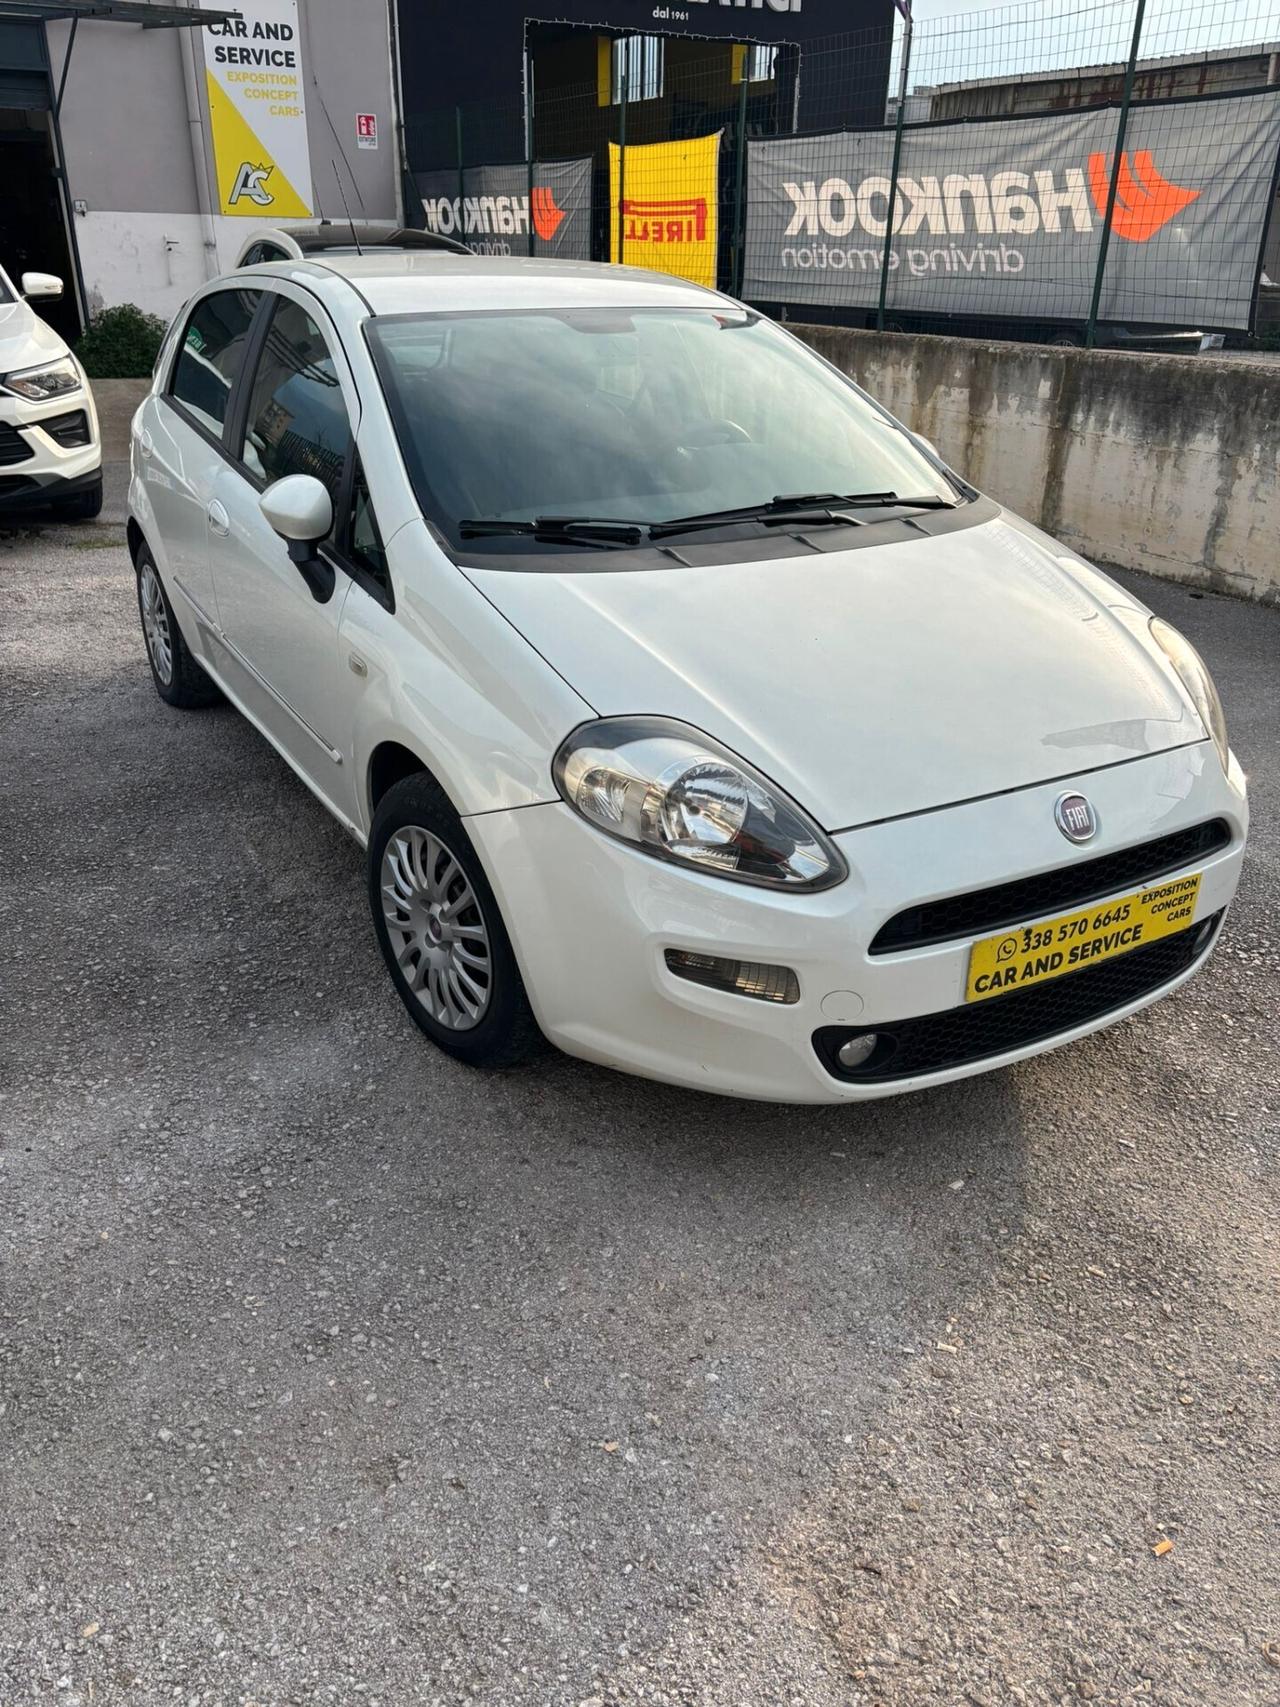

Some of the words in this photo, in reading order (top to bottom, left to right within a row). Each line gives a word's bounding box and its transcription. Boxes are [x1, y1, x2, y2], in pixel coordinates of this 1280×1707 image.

[652, 6, 669, 19] dal
[671, 11, 689, 21] 1961
[208, 20, 248, 38] CAR
[252, 22, 294, 41] AND
[214, 45, 296, 68] SERVICE
[226, 71, 297, 85] EXPOSITION
[243, 88, 299, 100] CONCEPT
[269, 105, 299, 116] CARS
[1065, 804, 1090, 831] FIAT
[1141, 877, 1198, 905] EXPOSITION
[1150, 891, 1196, 914] CONCEPT
[1166, 906, 1192, 922] CARS
[1020, 928, 1053, 953] 338
[1057, 918, 1087, 942] 570
[1092, 903, 1132, 931] 6645
[974, 965, 1017, 994] CAR
[1020, 952, 1064, 980] AND
[1068, 923, 1143, 965] SERVICE
